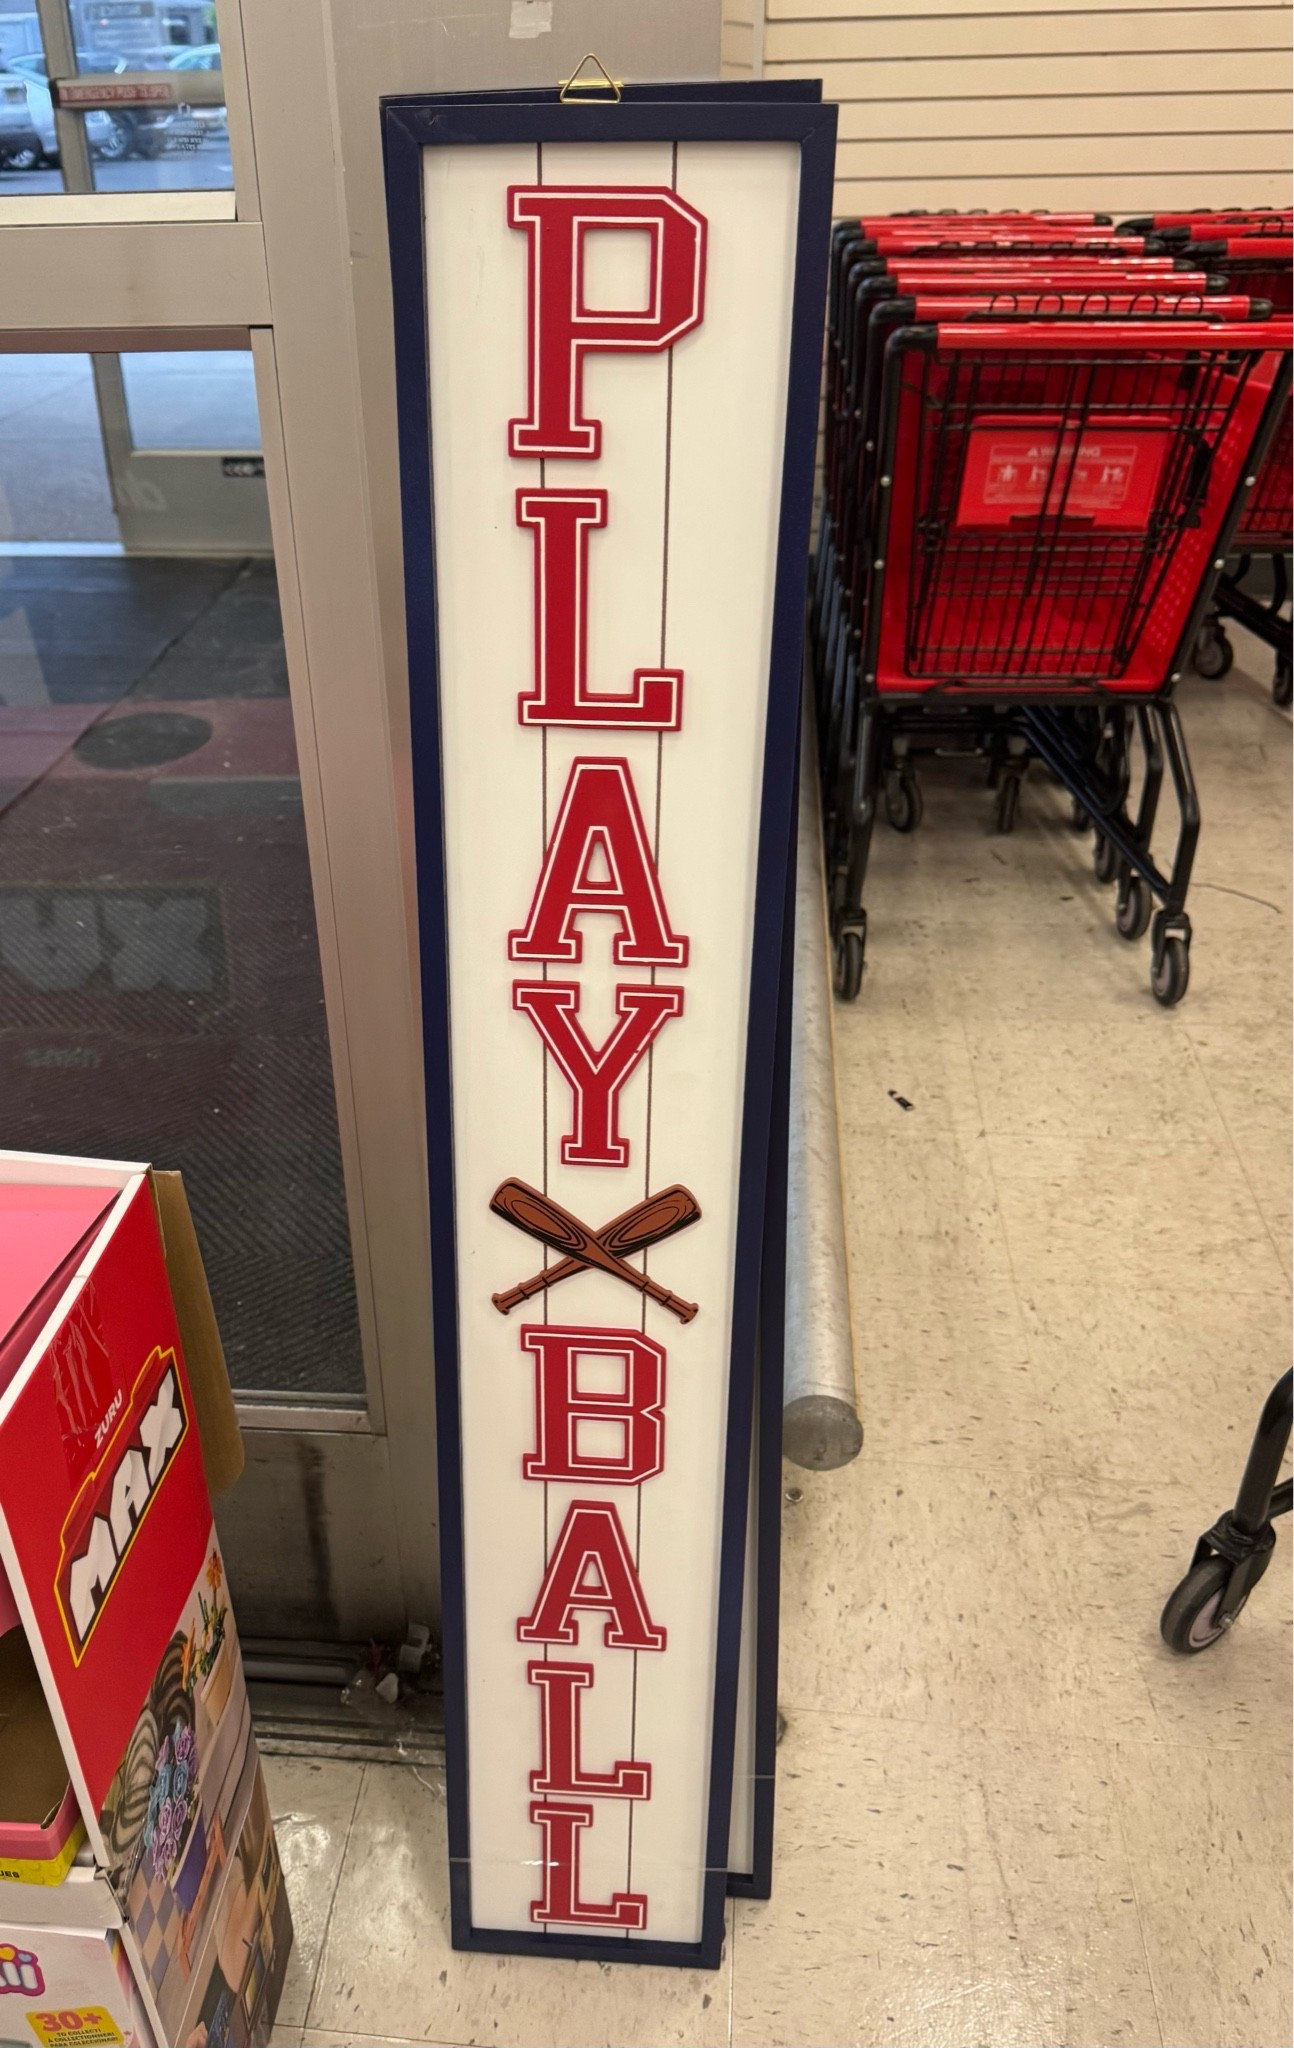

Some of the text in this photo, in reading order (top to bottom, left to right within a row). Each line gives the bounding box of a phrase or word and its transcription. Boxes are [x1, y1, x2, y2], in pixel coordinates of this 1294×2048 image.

[507, 186, 707, 1168] PLAY
[69, 1366, 184, 1642] MAX
[94, 1388, 123, 1449] ZURU
[517, 1323, 667, 1931] BALL
[35, 2010, 103, 2032] 30+
